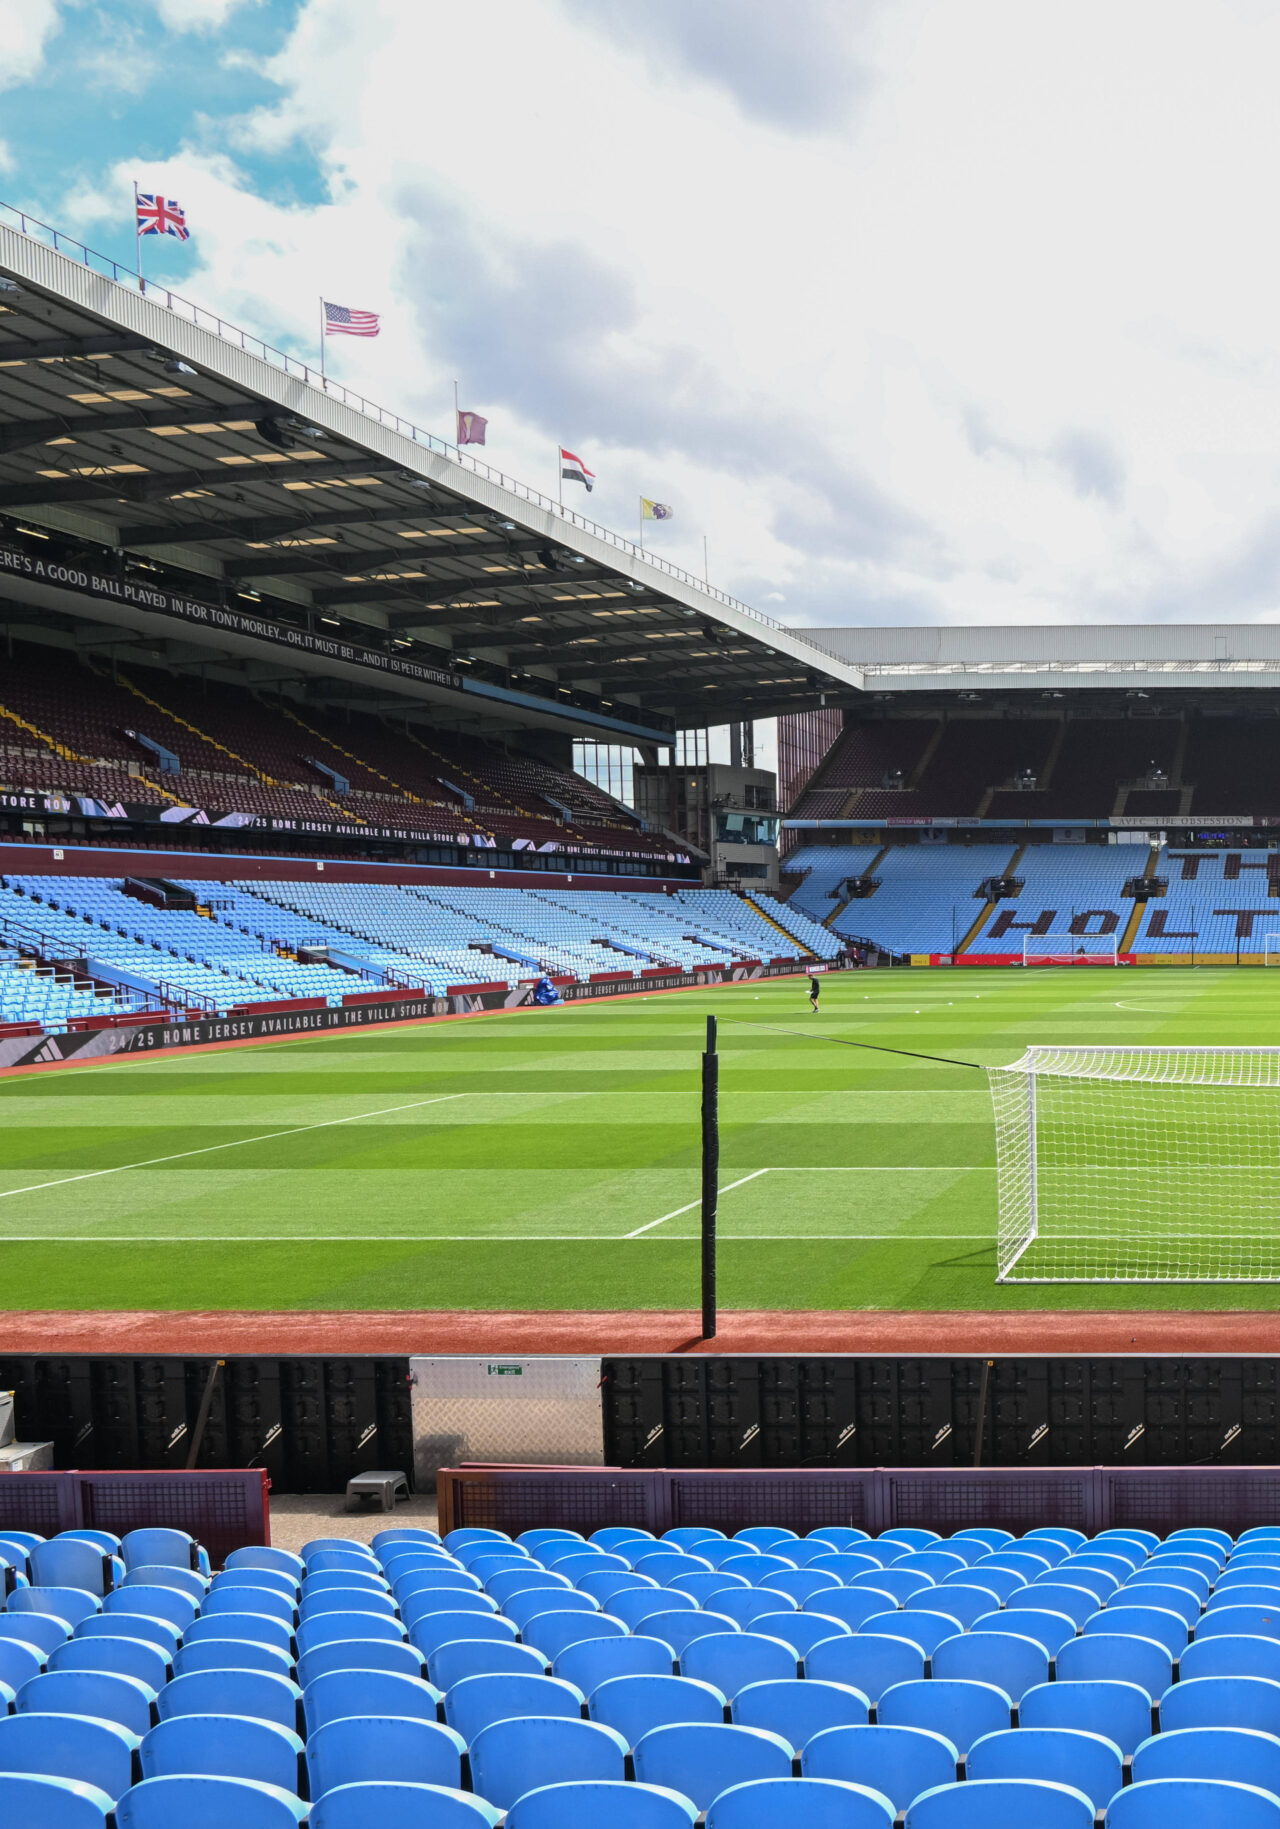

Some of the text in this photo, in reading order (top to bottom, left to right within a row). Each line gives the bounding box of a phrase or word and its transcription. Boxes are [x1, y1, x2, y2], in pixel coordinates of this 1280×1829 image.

[35, 561, 45, 576] A
[47, 564, 87, 587] GOOD
[91, 576, 122, 596] BALL
[124, 585, 167, 608] PLAYED
[171, 598, 183, 614] IN
[186, 603, 208, 620] FOR
[209, 609, 239, 628] TONY
[315, 639, 339, 655] MUST
[340, 646, 354, 660] BE!
[401, 663, 422, 677] PETER
[44, 799, 71, 810] NOW
[272, 819, 297, 829] HOME
[301, 821, 332, 832] JERSEY
[336, 825, 379, 837] AVAILABLE
[382, 829, 391, 837] IN
[394, 829, 407, 839] THE
[410, 831, 430, 840] VILLA
[433, 833, 454, 842] STORE
[1181, 817, 1243, 825] OBSESSION
[595, 984, 615, 995] JERSEY
[617, 981, 645, 992] AVAILABLE
[666, 976, 680, 986] VILLA
[110, 1032, 154, 1051] 24/25
[163, 1027, 200, 1044] HOME
[208, 1021, 254, 1039] JERSEY
[261, 1015, 322, 1033] AVAILABLE
[328, 1013, 339, 1025] IN
[345, 1010, 362, 1024] THE
[368, 1006, 396, 1020] VILLA
[400, 1003, 428, 1017] STORE
